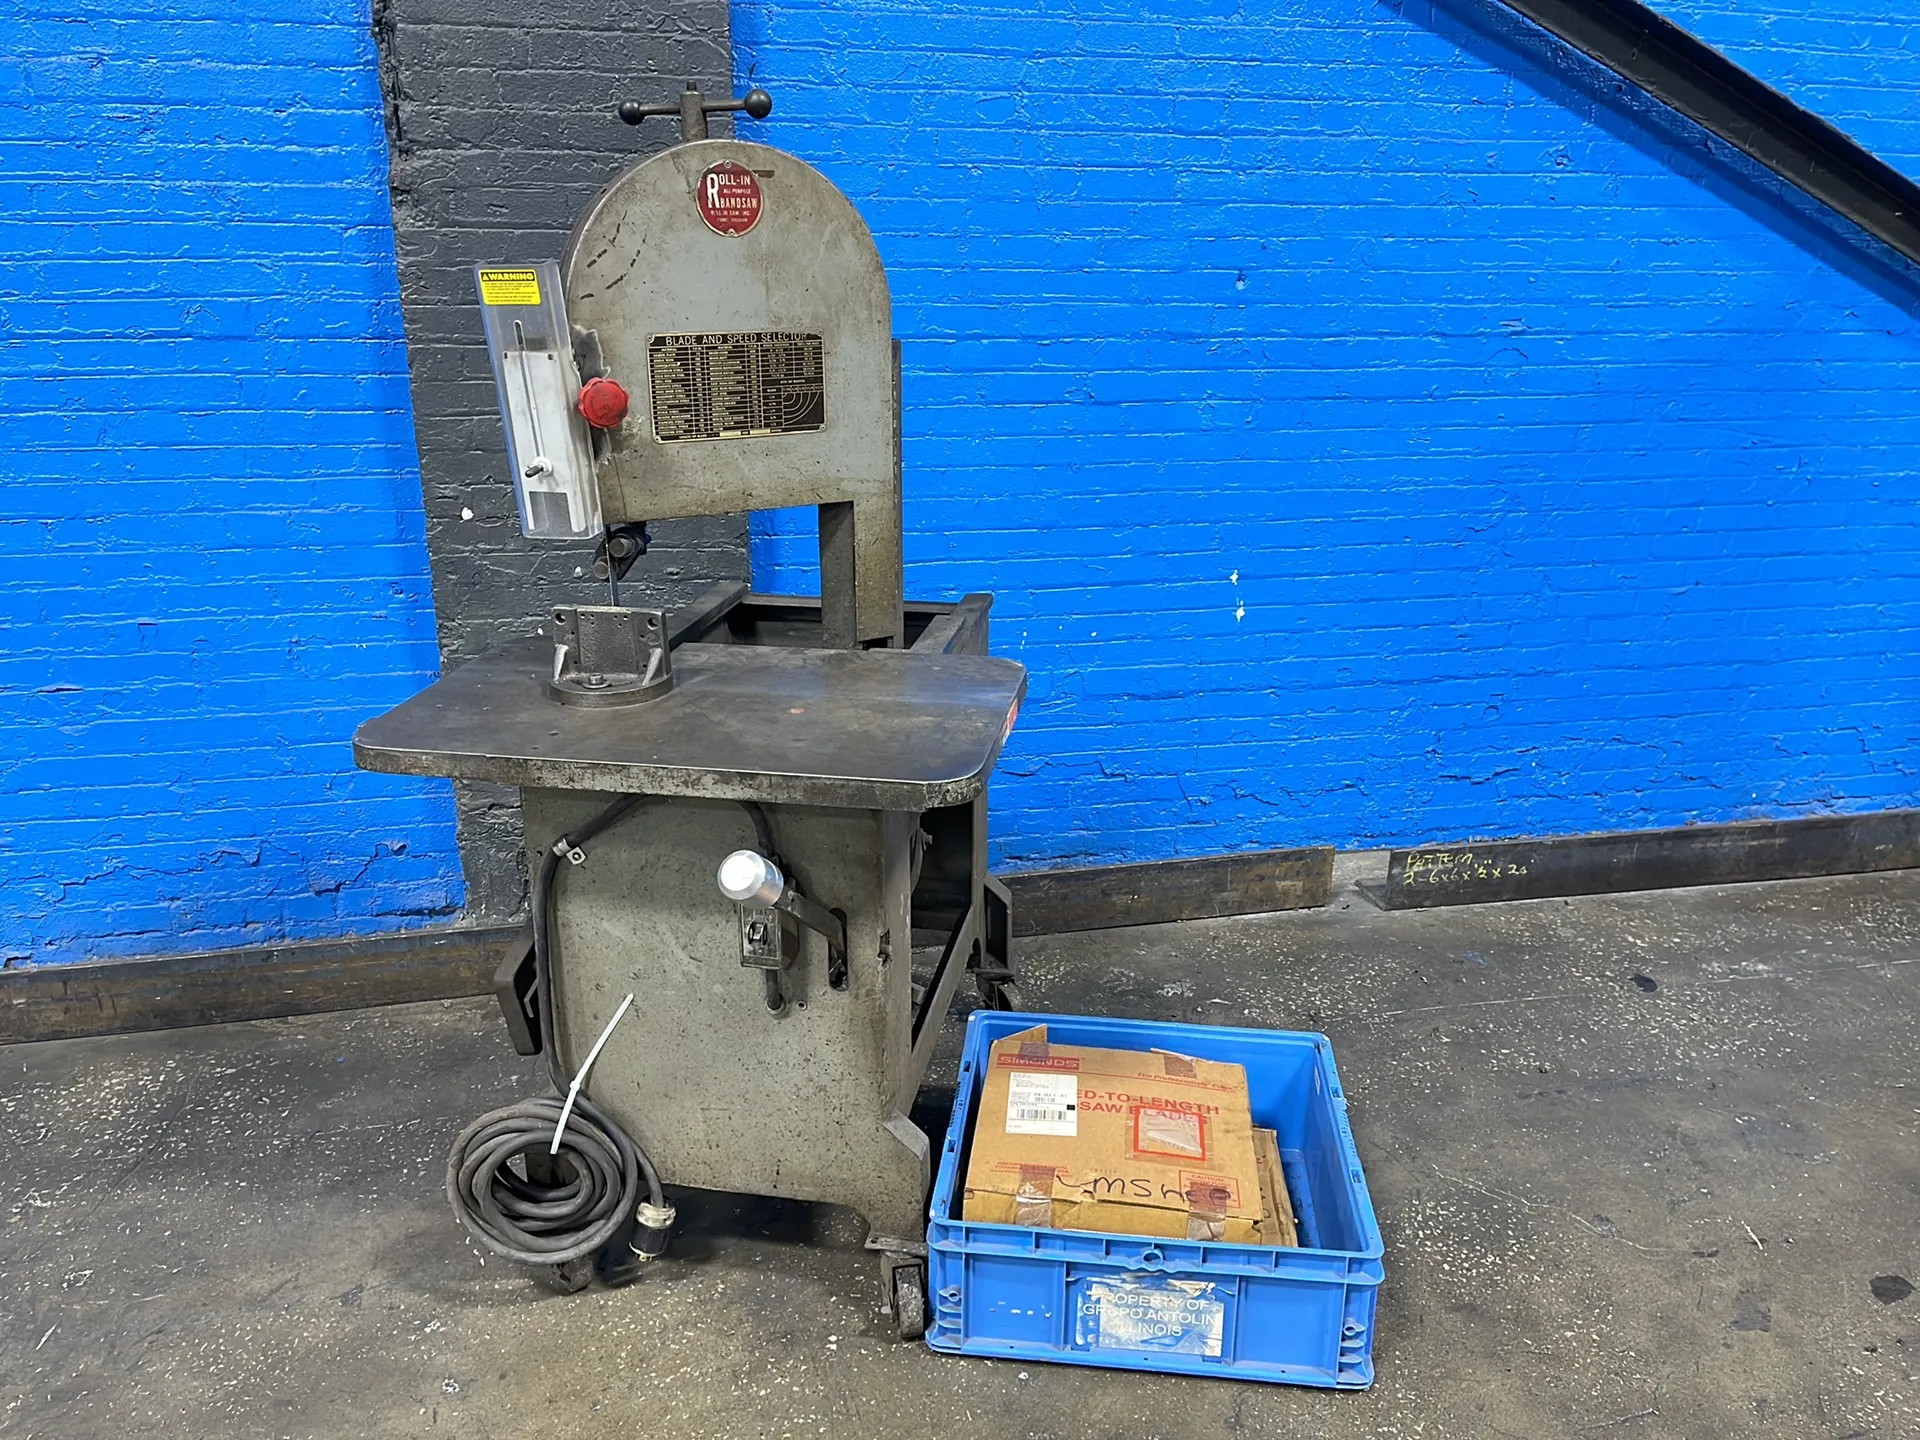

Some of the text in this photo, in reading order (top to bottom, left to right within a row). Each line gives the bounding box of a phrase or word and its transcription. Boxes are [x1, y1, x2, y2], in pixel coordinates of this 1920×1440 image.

[720, 198, 758, 208] BANDSAW
[487, 272, 534, 281] WARNING
[665, 332, 808, 346] BLADE AND SPEED SELECTOR
[1000, 1056, 1078, 1068] SIMONDS
[1077, 1089, 1219, 1115] ED-TO-LENGTH
[1079, 1102, 1122, 1115] SAW
[1186, 1299, 1209, 1311] OF
[1145, 1309, 1217, 1326] ANTOLIN
